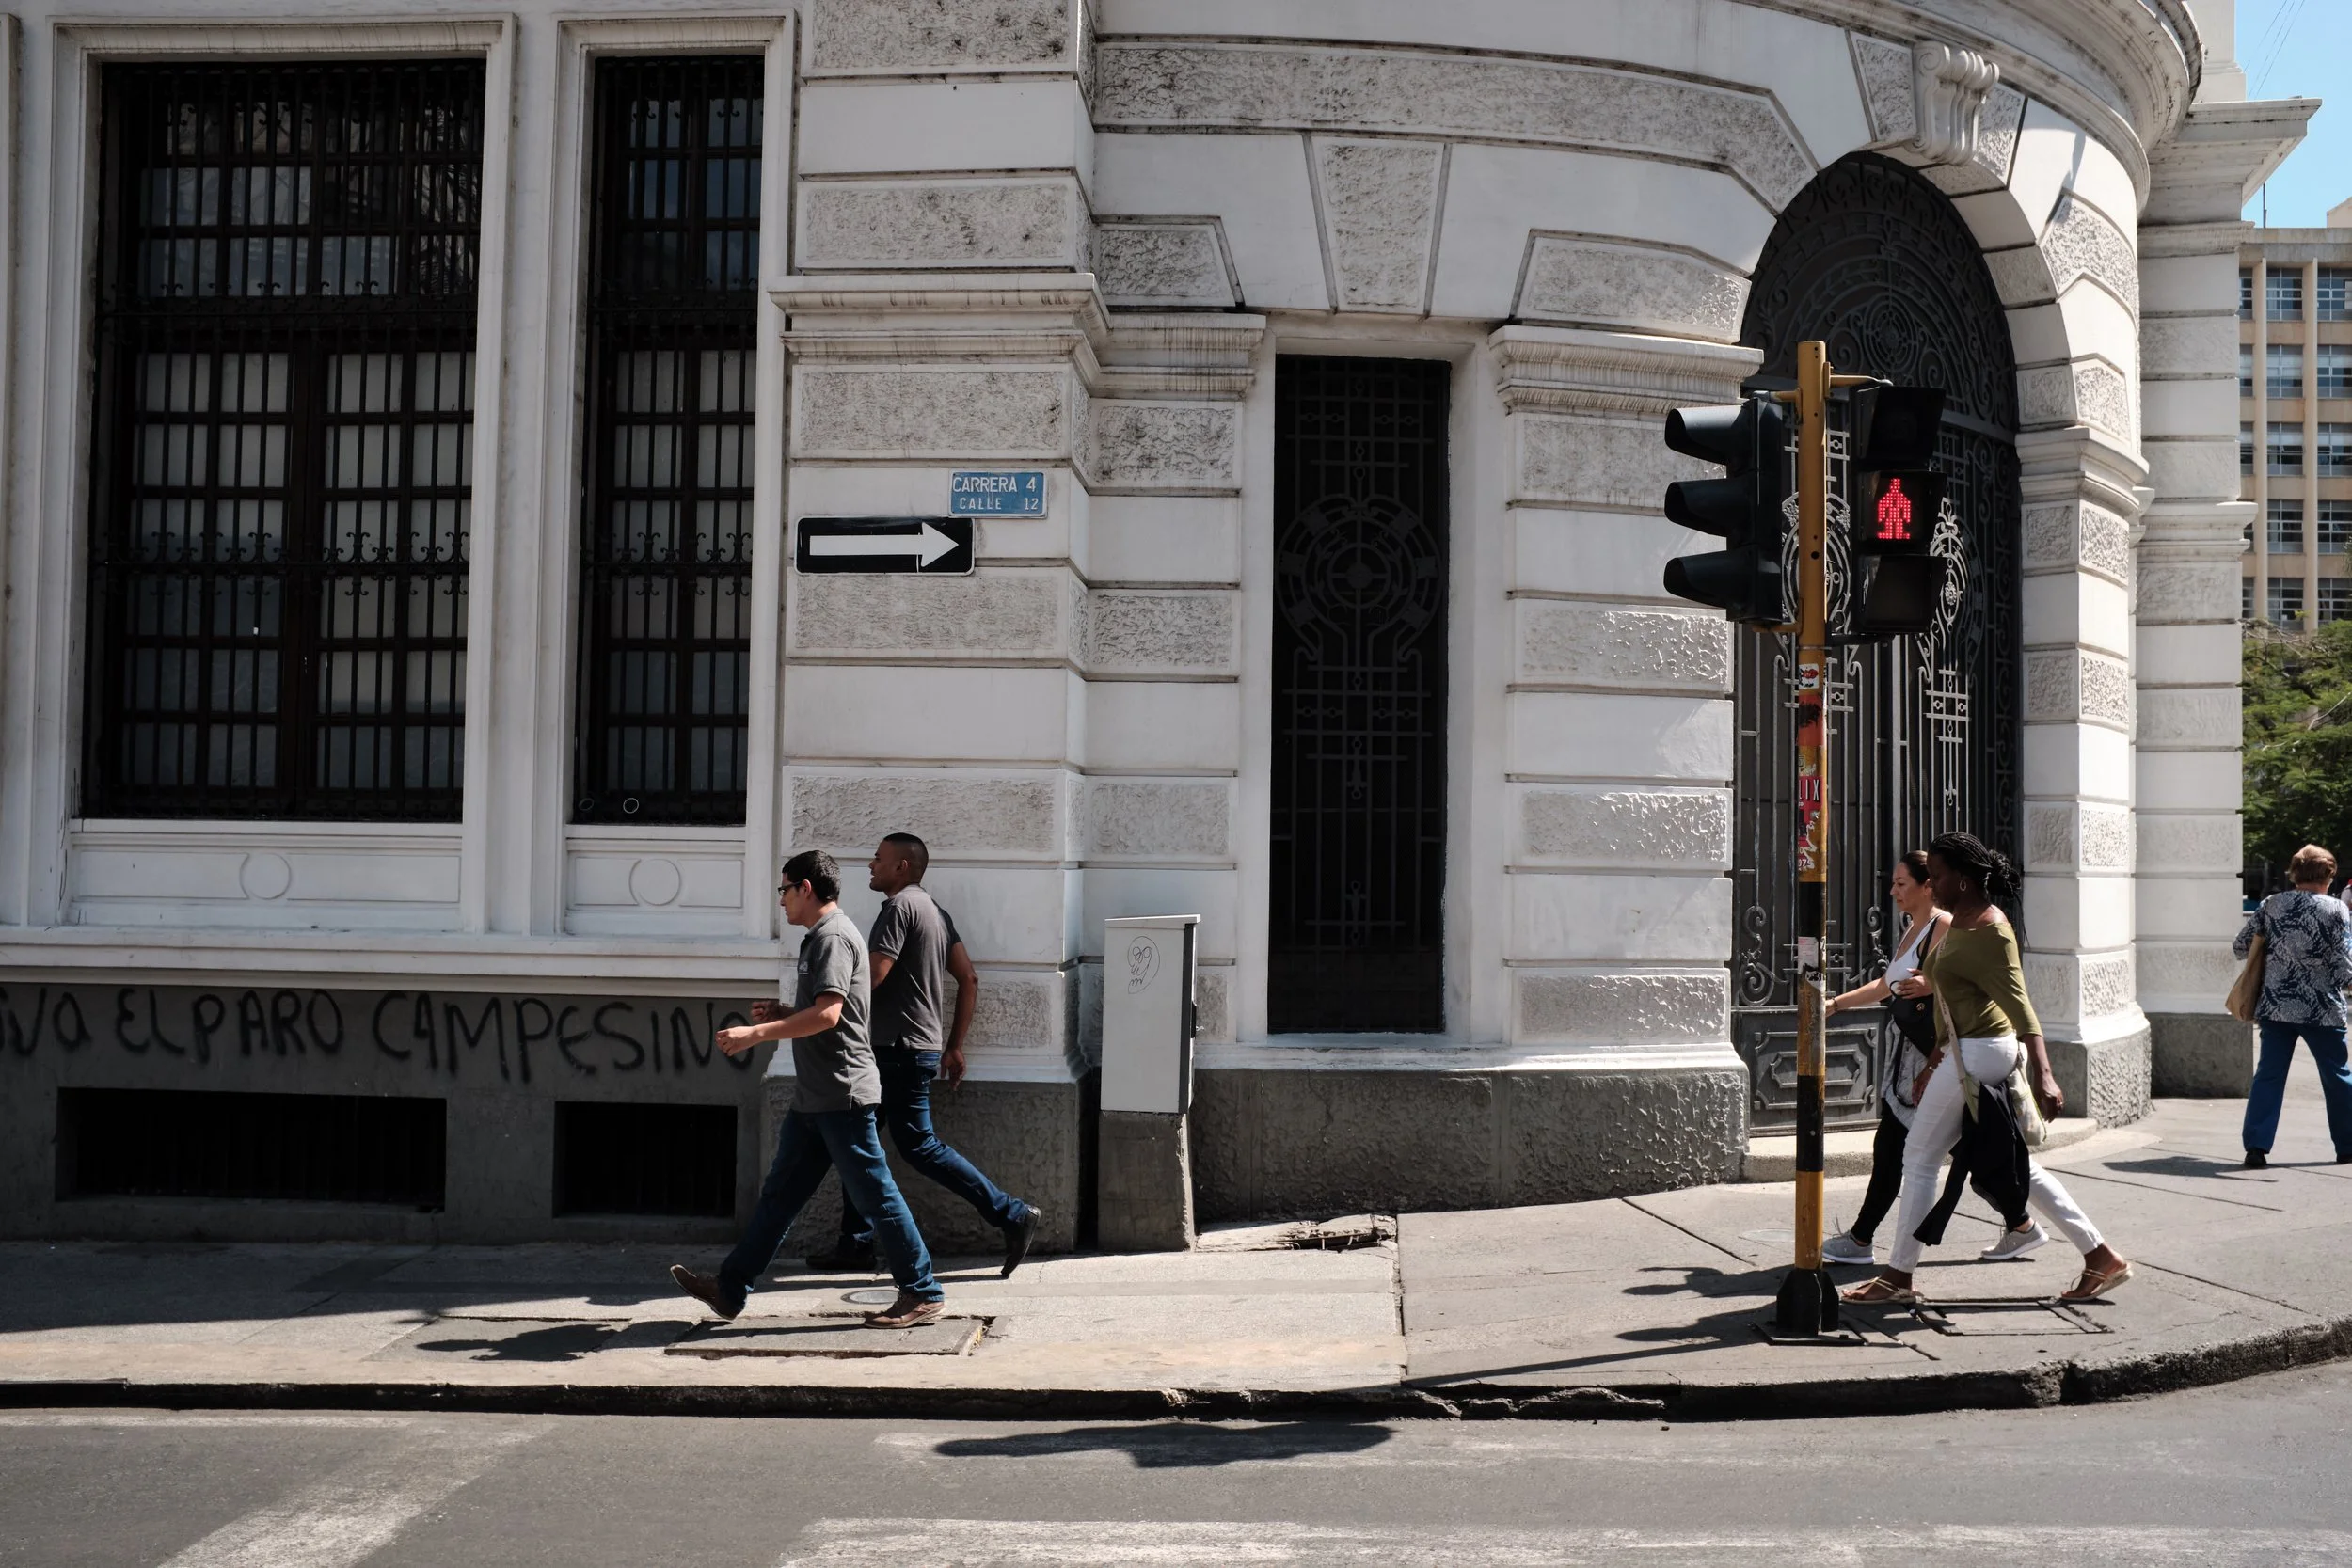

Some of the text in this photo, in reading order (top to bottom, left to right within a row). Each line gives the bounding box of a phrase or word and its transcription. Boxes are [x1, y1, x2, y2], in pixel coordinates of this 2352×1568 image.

[953, 477, 1036, 492] CARRERA 4
[960, 497, 1039, 510] CALLE 12
[116, 988, 184, 1054] EL
[192, 990, 344, 1063] PARO
[373, 991, 754, 1083] CAMPESINO
